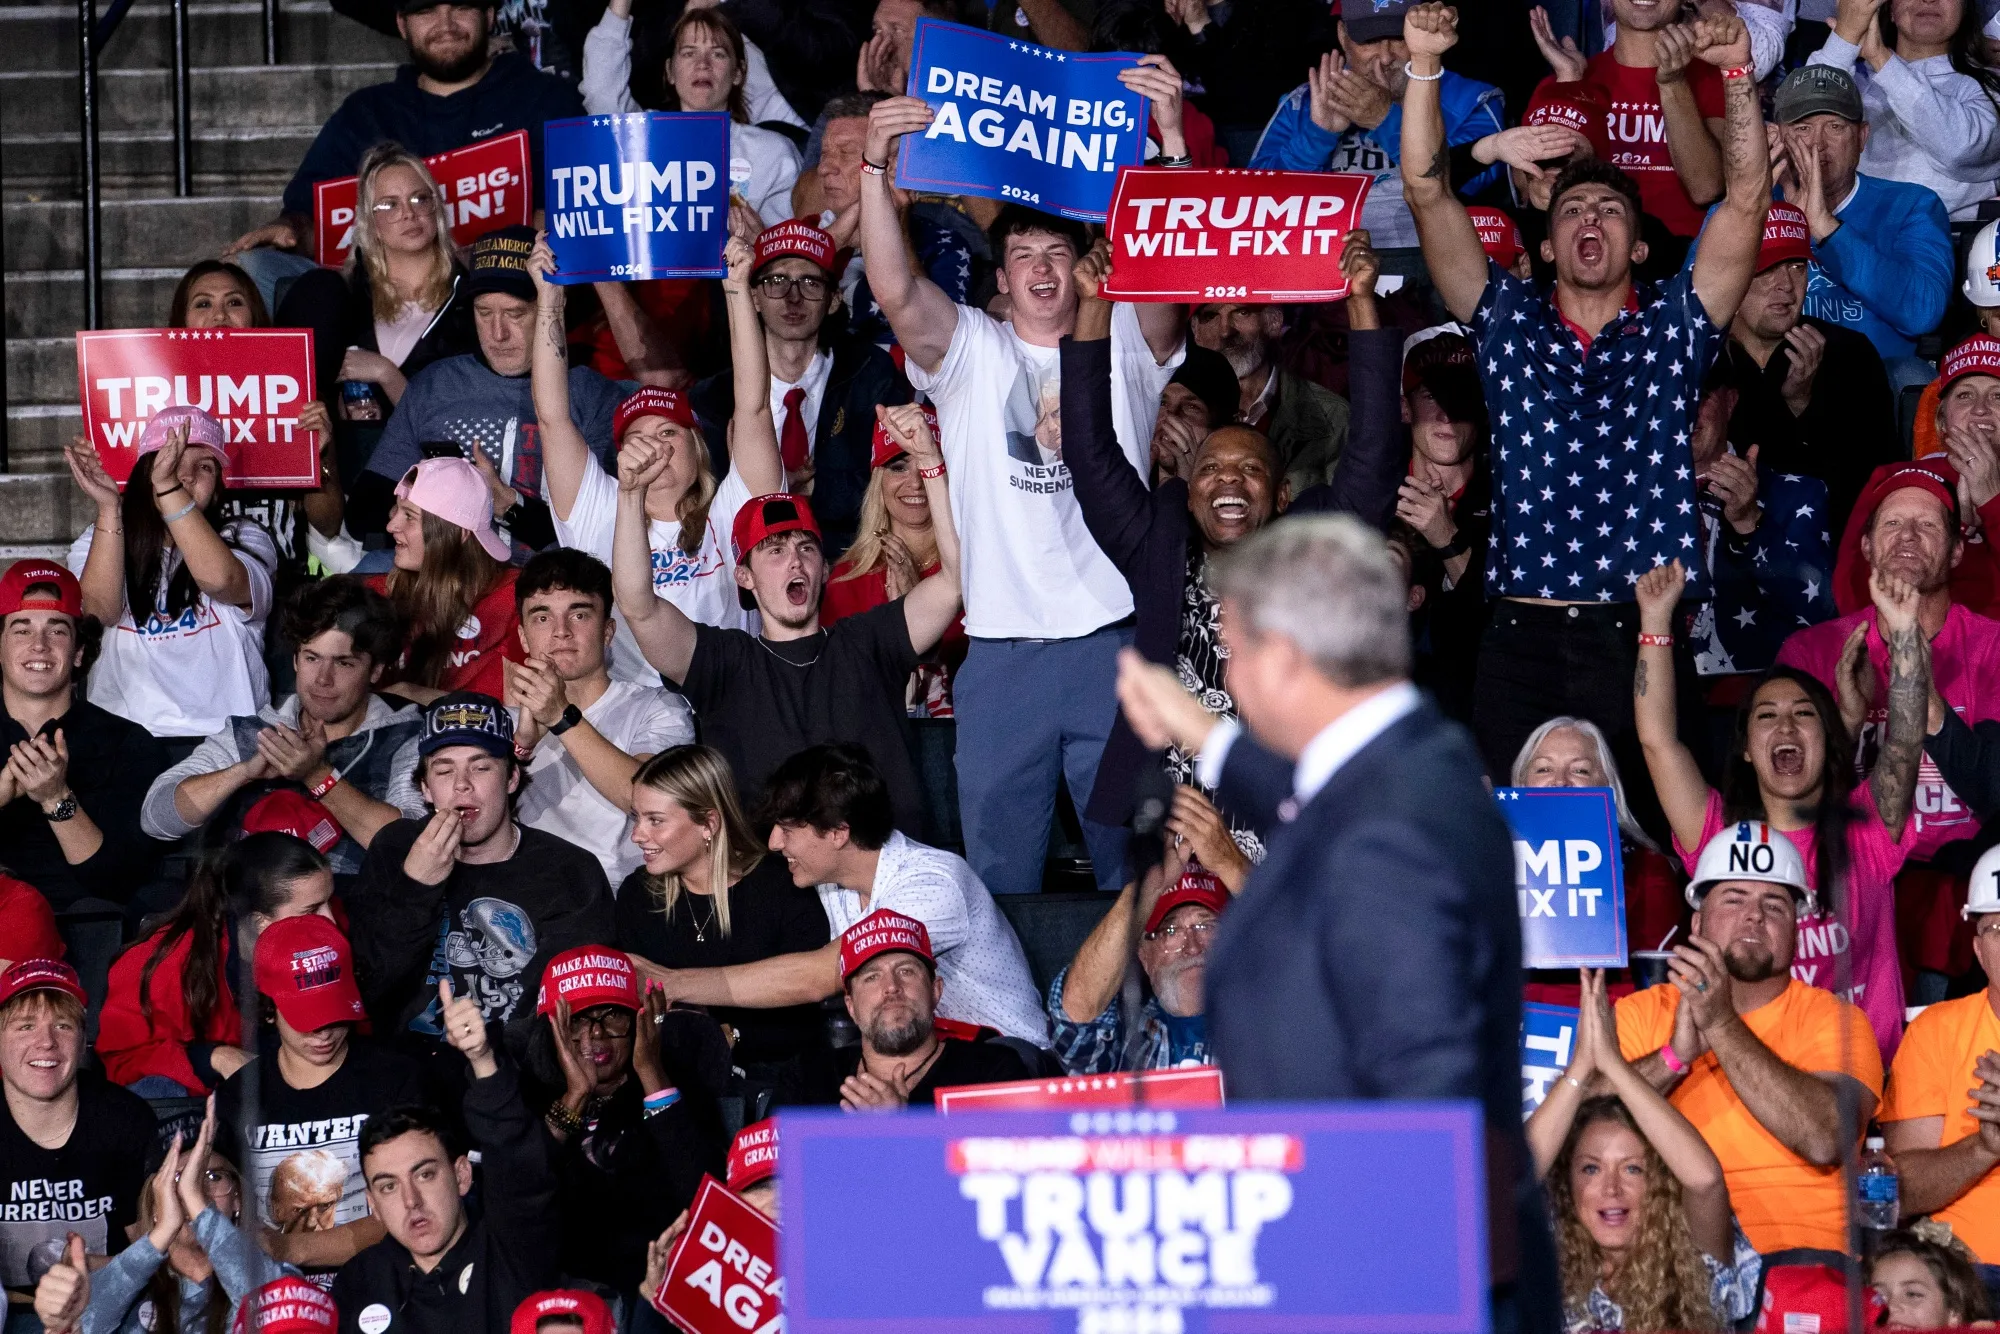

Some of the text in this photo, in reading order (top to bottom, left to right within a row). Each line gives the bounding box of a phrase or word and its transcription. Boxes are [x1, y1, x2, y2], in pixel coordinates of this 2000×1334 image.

[1792, 68, 1848, 90] RETIRED
[927, 67, 1135, 132] DREAM BIG,
[1529, 106, 1587, 124] TRUMP
[925, 101, 1118, 172] AGAIN!
[1607, 113, 1667, 143] RUM
[457, 167, 519, 197] BIG,
[552, 161, 716, 209] TRUMP
[1001, 184, 1040, 204] 2024
[553, 206, 714, 239] WILL FIX IT
[1127, 196, 1345, 230] TRUMP
[1472, 215, 1506, 228] ERICA
[1768, 209, 1807, 225] AMERICA
[760, 225, 830, 247] MAKE AMERICA
[1124, 229, 1338, 257] WILL FIX IT
[1479, 231, 1502, 243] GAIN
[1780, 226, 1806, 240] AGAIN
[491, 238, 532, 254] AMERIC
[762, 239, 825, 259] GREAT AGAIN
[497, 256, 527, 271] AGAI
[610, 264, 644, 276] 2024
[1204, 286, 1247, 298] 2024
[1945, 343, 1970, 365] MAKE
[1948, 356, 1979, 375] GREAT
[97, 375, 299, 419] TRUMP
[640, 389, 678, 399] AMERICA
[648, 399, 675, 410] AGAIN
[267, 418, 299, 443] IT
[924, 468, 940, 478] VIP
[1024, 464, 1071, 478] NEVE
[1010, 474, 1073, 494] SURREND
[24, 569, 60, 578] TRUMP
[138, 609, 196, 635] 024
[1653, 636, 1670, 645] VIP
[311, 784, 327, 796] VIP
[1729, 843, 1775, 873] NO
[1518, 888, 1603, 917] IX IT
[846, 921, 877, 944] MAKE
[854, 932, 888, 955] GREAT
[1797, 922, 1849, 959] IND
[290, 951, 339, 970] I STAND
[306, 964, 329, 973] WITH
[552, 955, 631, 978] MAKE AMERICA
[559, 973, 627, 994] GREAT AGAIN
[738, 1129, 769, 1150] MAKE
[744, 1146, 779, 1167] GREAT
[11, 1178, 84, 1201] NEVER
[0, 1196, 113, 1221] RRENDER
[959, 1171, 1294, 1240] TRUMP
[699, 1220, 787, 1304] DREA
[998, 1230, 1260, 1289] VANCE
[256, 1304, 295, 1328] GREAT
